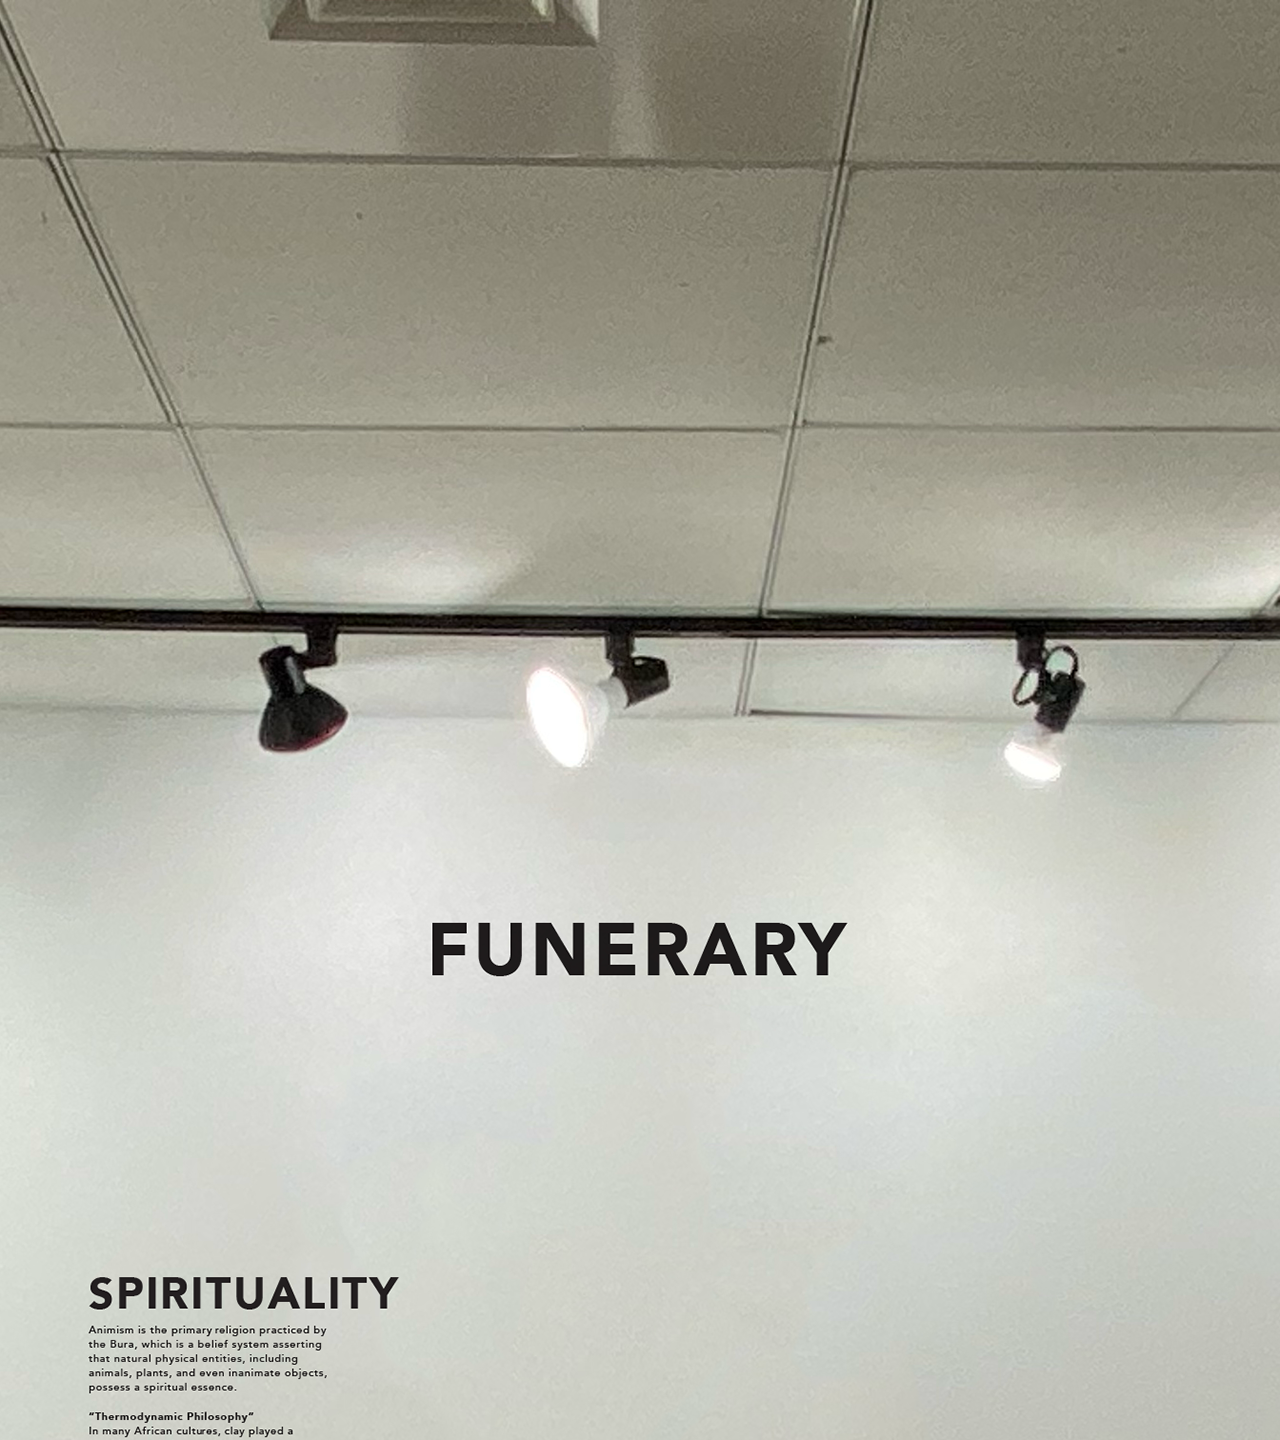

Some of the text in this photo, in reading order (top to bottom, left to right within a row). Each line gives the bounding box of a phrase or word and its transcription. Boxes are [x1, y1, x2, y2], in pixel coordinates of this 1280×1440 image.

[432, 922, 848, 977] FUNERARY
[89, 1276, 399, 1310] SPIRITUALITY
[88, 1324, 327, 1338] Animism is the primary religion practiced by
[88, 1367, 328, 1380] animals, plants, and even inanimate objects,
